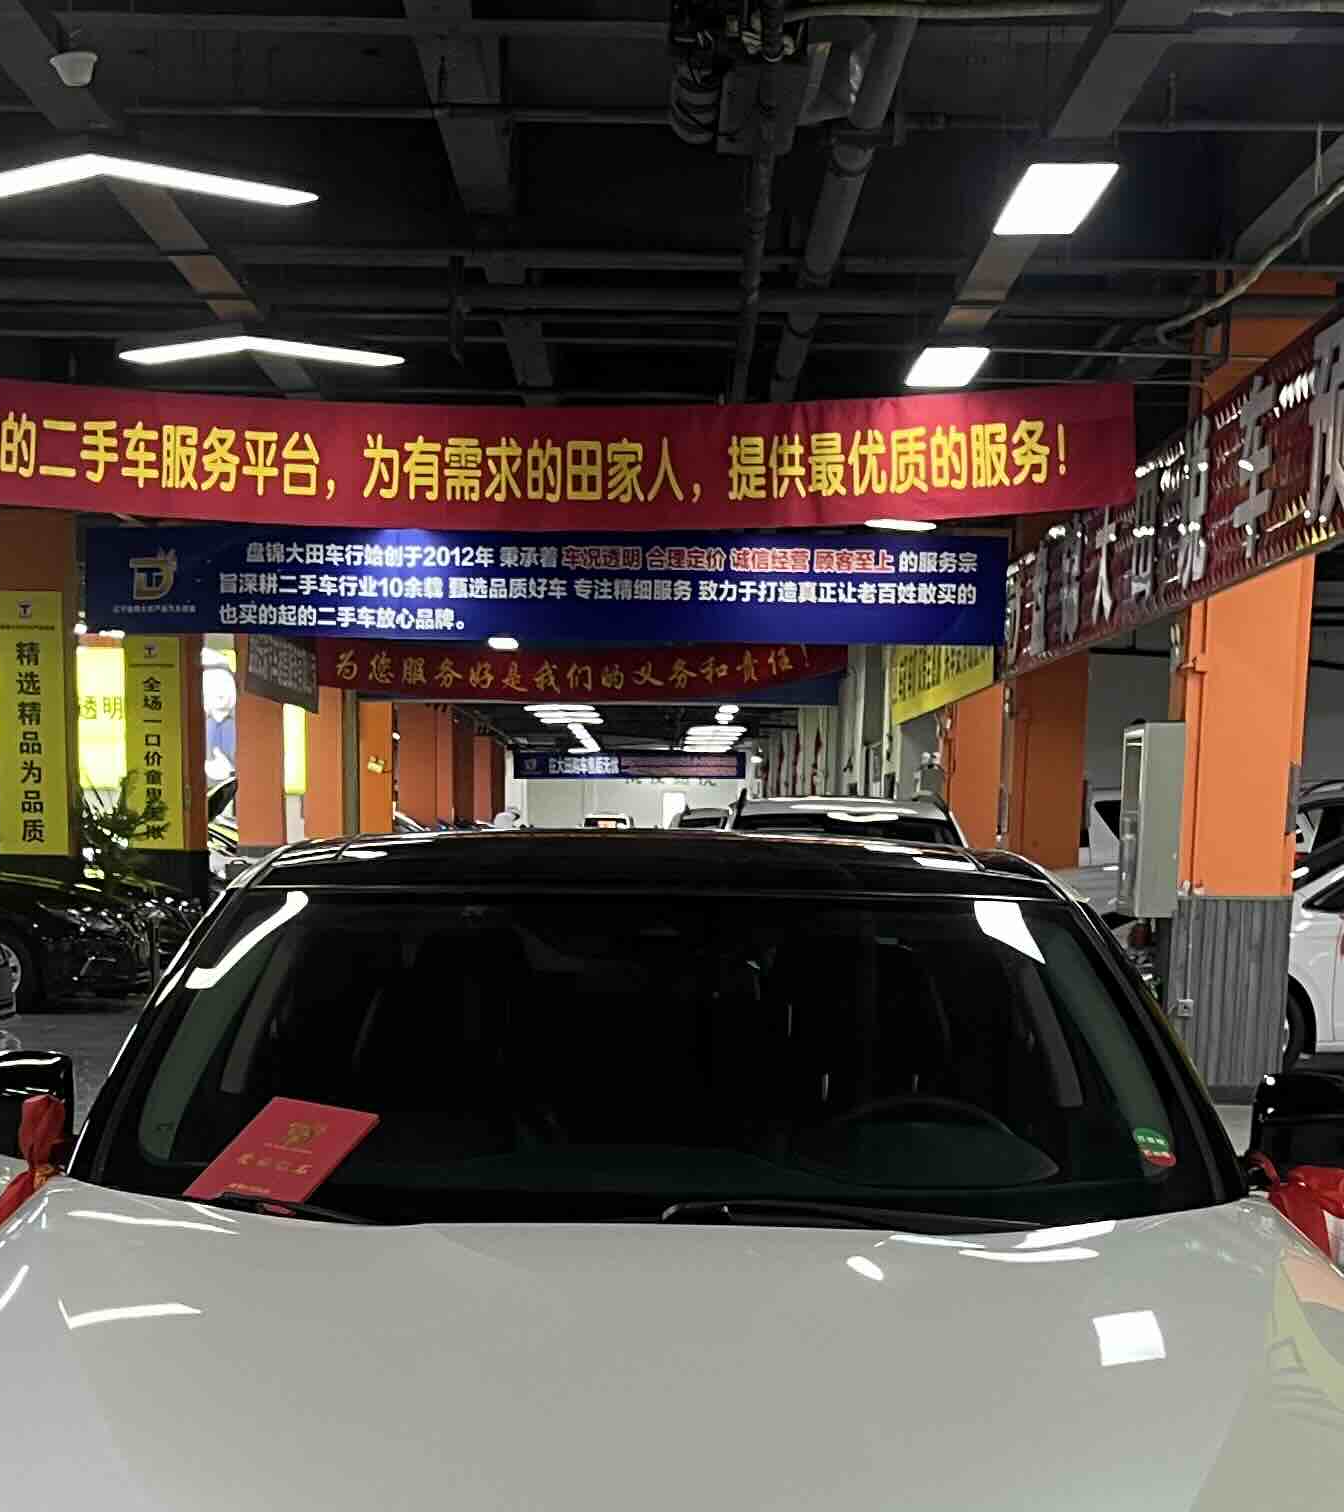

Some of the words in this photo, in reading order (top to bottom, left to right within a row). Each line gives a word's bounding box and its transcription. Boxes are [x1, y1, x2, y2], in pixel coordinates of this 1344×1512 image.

[246, 542, 495, 568] 盘锦大田车行始创于2012年
[645, 547, 726, 571] 合理定价
[730, 547, 810, 573] 诚信经营
[813, 549, 896, 574] 顾客至上
[898, 551, 979, 573] 的服务宗
[219, 572, 444, 599] 旨深耕二手车行业10余载
[448, 576, 568, 600] 甄选品质好车
[573, 578, 693, 601] 专注精细服务
[698, 579, 978, 605] 致力于打造真正让老百姓敢买的
[219, 603, 465, 631] 也买的起的二手车放心品牌。
[16, 641, 45, 843] 精选精品为品质
